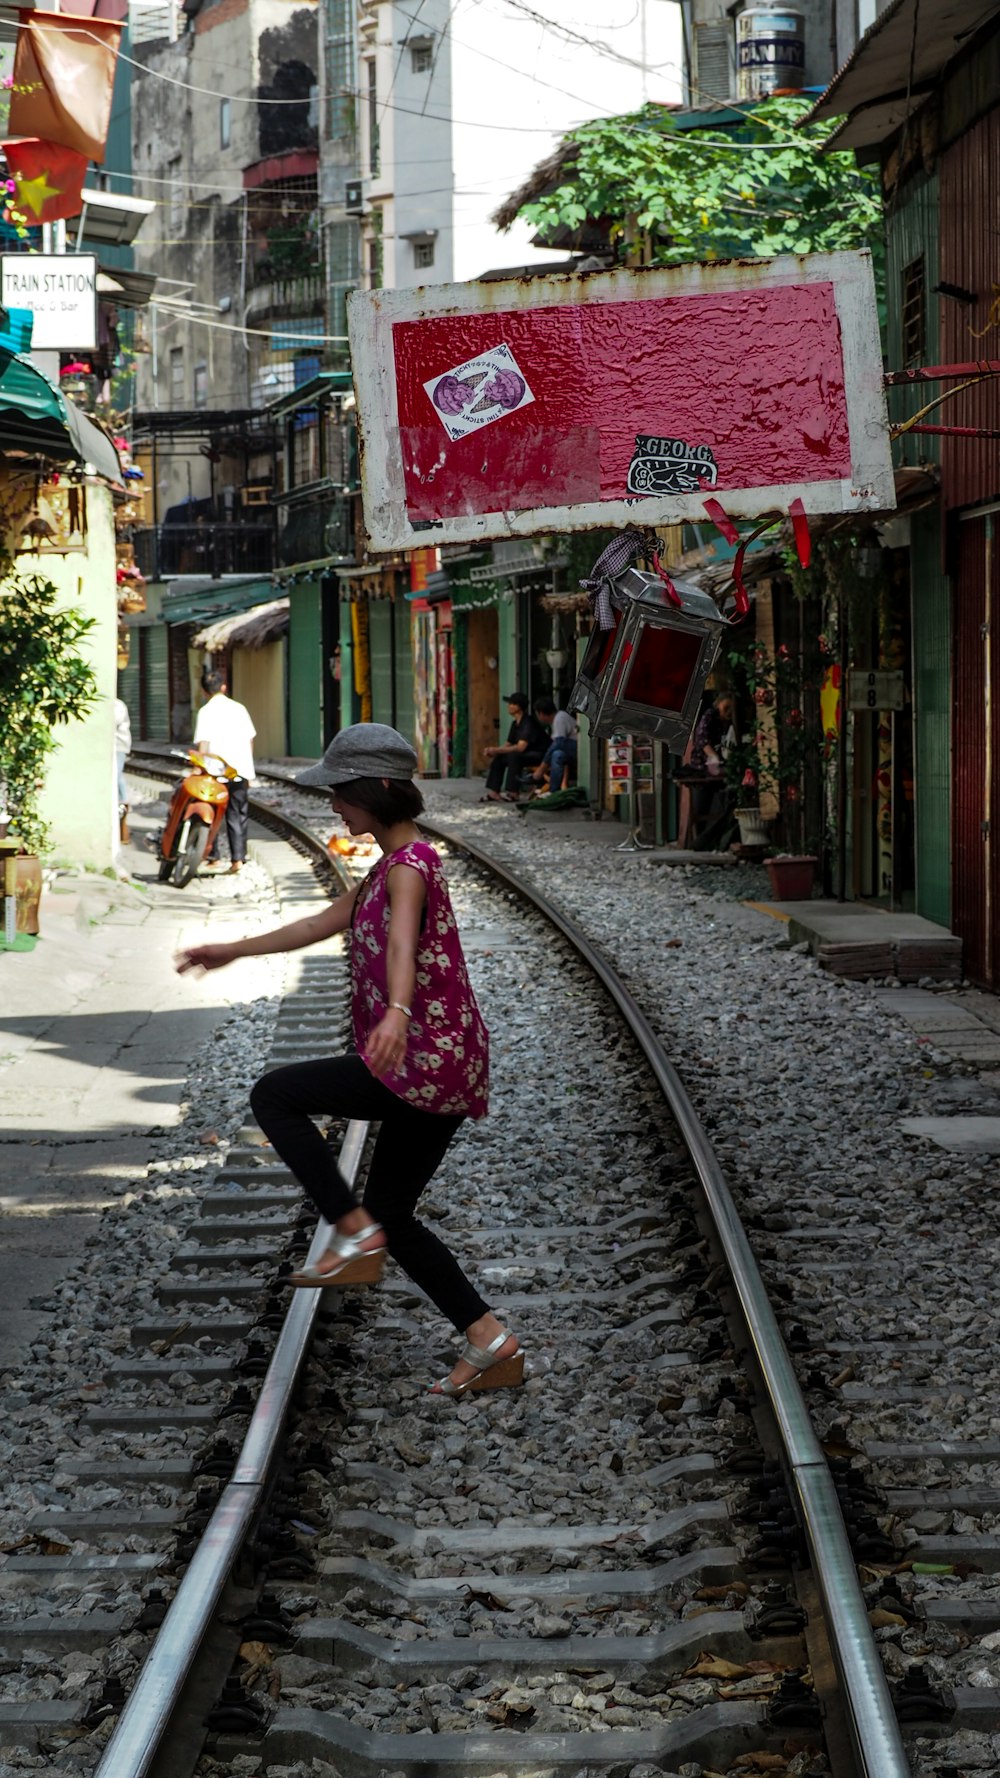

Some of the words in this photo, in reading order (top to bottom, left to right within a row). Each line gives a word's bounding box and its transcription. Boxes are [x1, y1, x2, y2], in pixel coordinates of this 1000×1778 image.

[4, 273, 39, 292] TRAIN
[43, 273, 95, 292] STATION
[60, 301, 79, 311] Bar
[460, 413, 484, 423] STICKY
